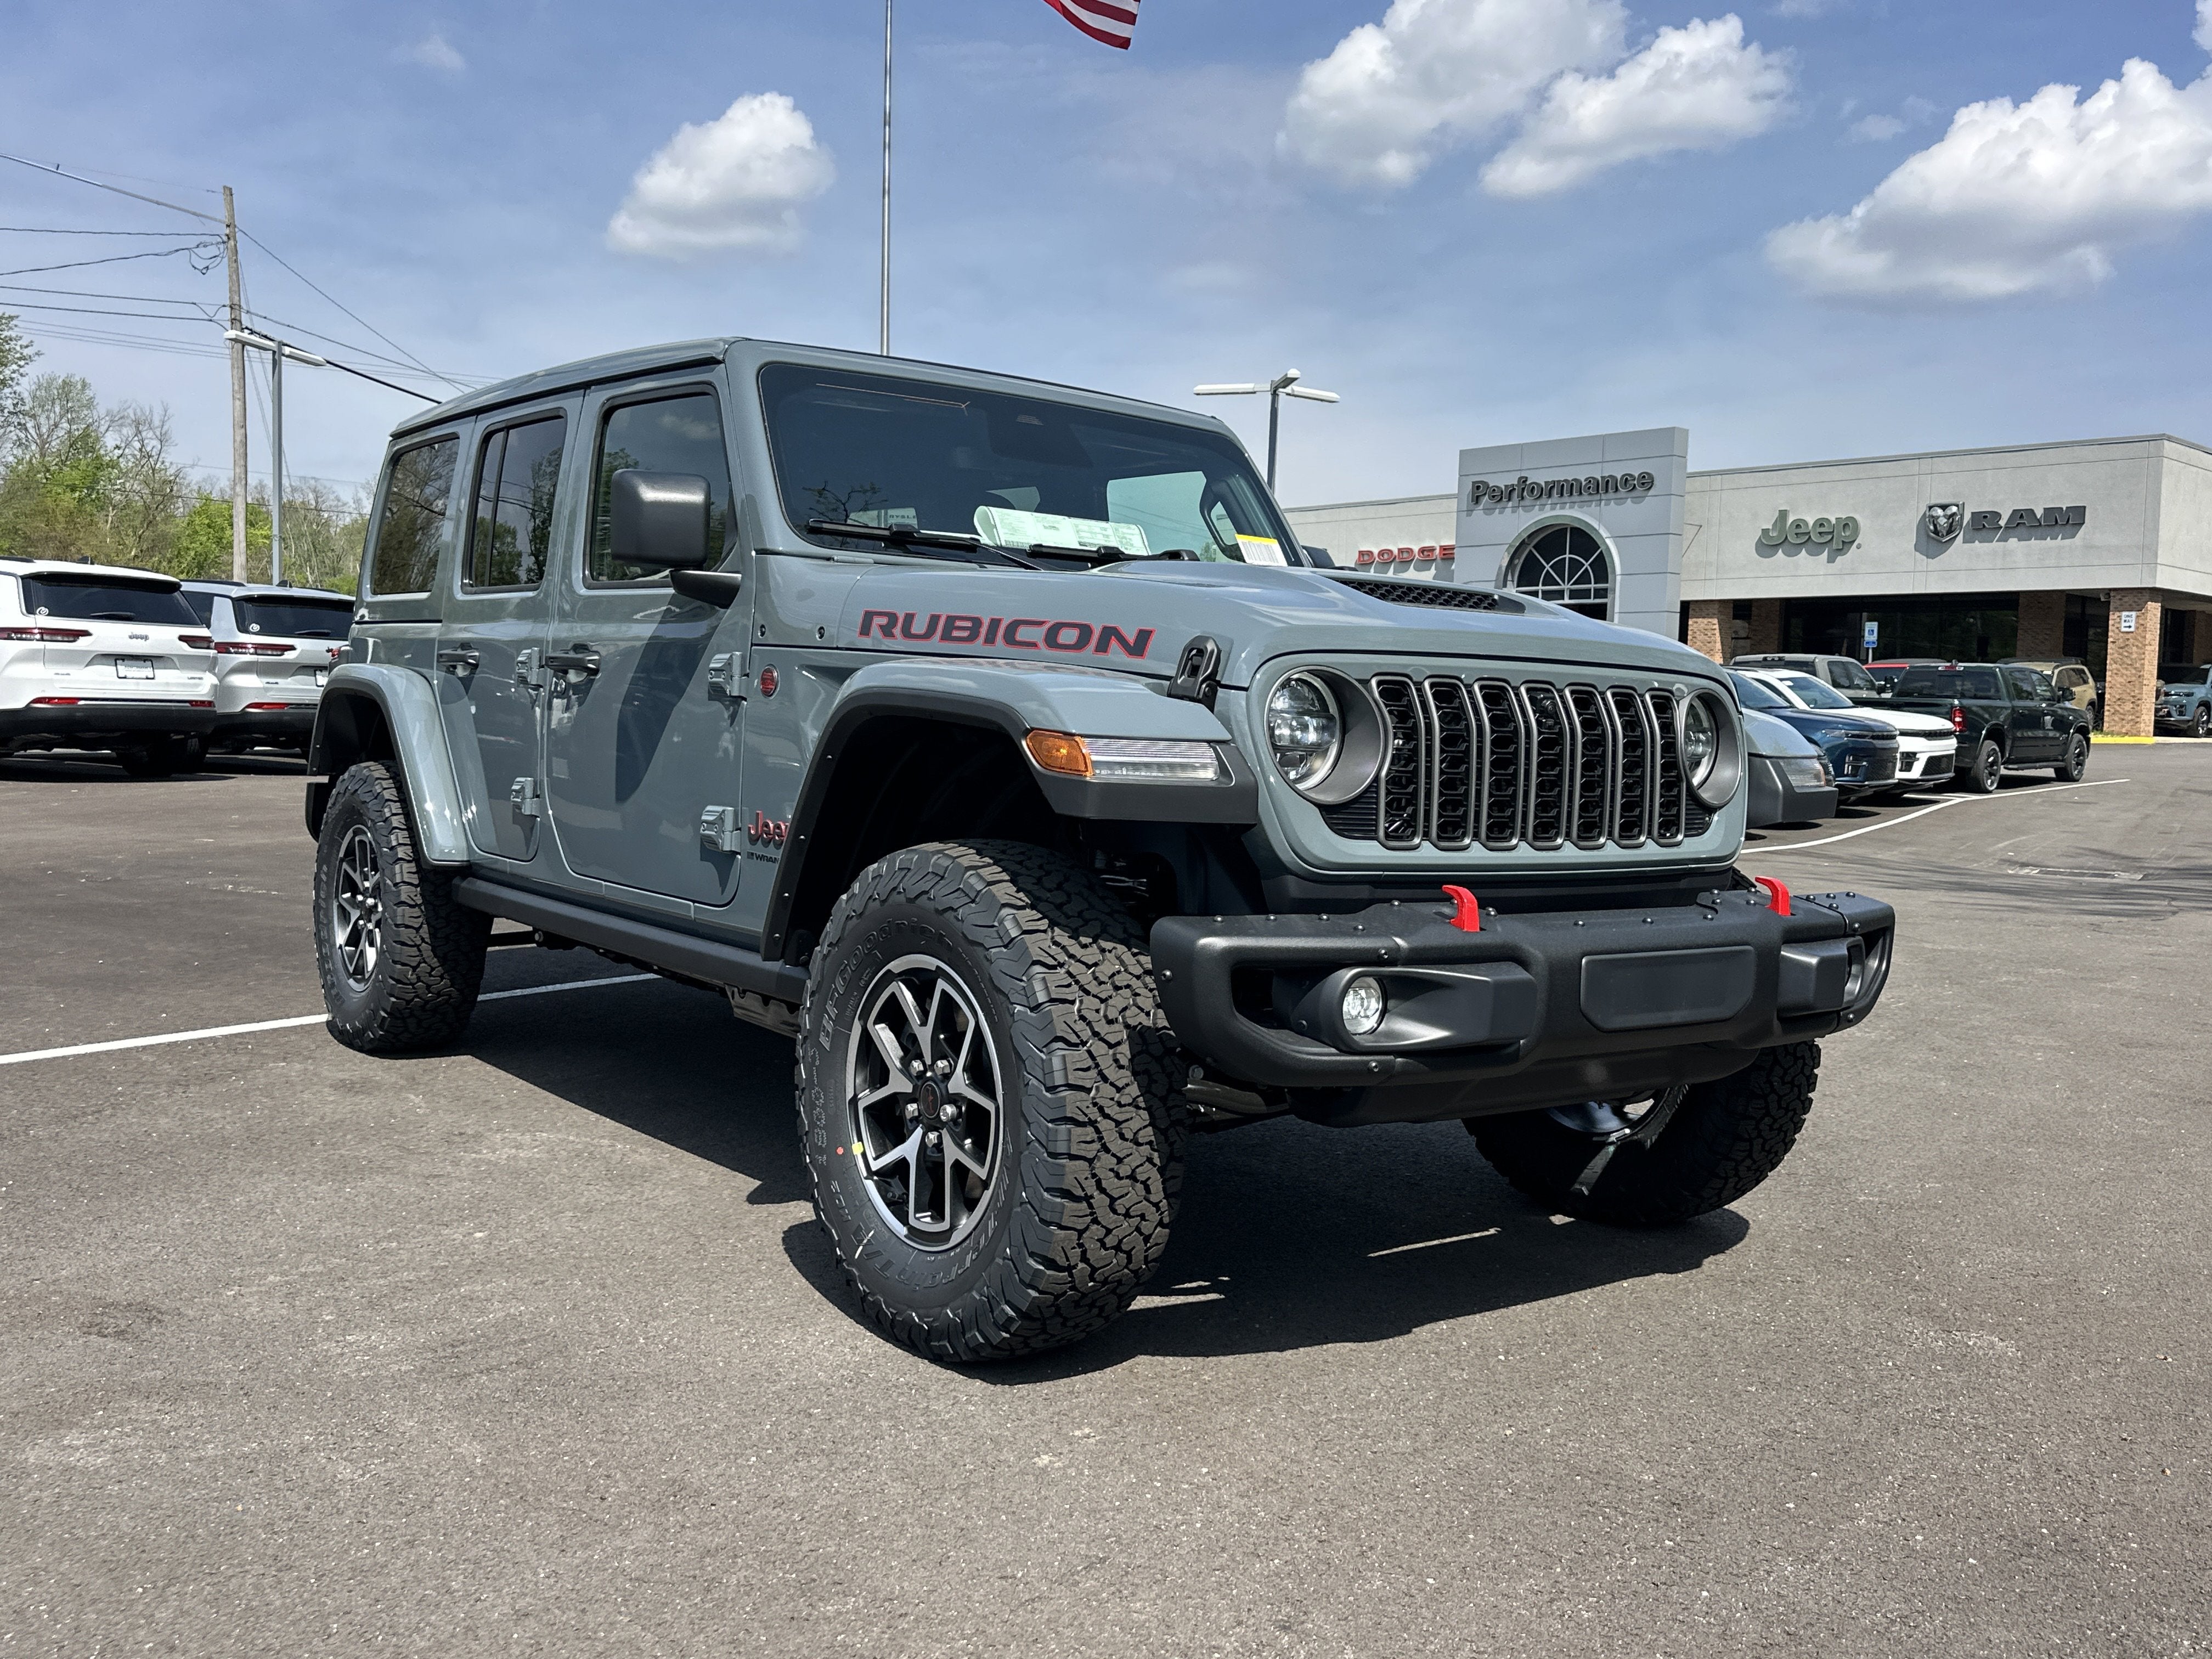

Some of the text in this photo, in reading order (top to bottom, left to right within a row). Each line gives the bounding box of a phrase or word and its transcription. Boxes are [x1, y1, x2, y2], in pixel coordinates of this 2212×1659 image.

[1470, 471, 1654, 504] Performance
[1760, 510, 1859, 550] Jeep
[1971, 505, 2086, 529] RAM
[1357, 544, 1455, 565] DODGE
[128, 632, 149, 641] Jeep
[858, 609, 1156, 659] RUBICON
[747, 810, 789, 844] Jee
[819, 918, 953, 1051] BFGoodrich
